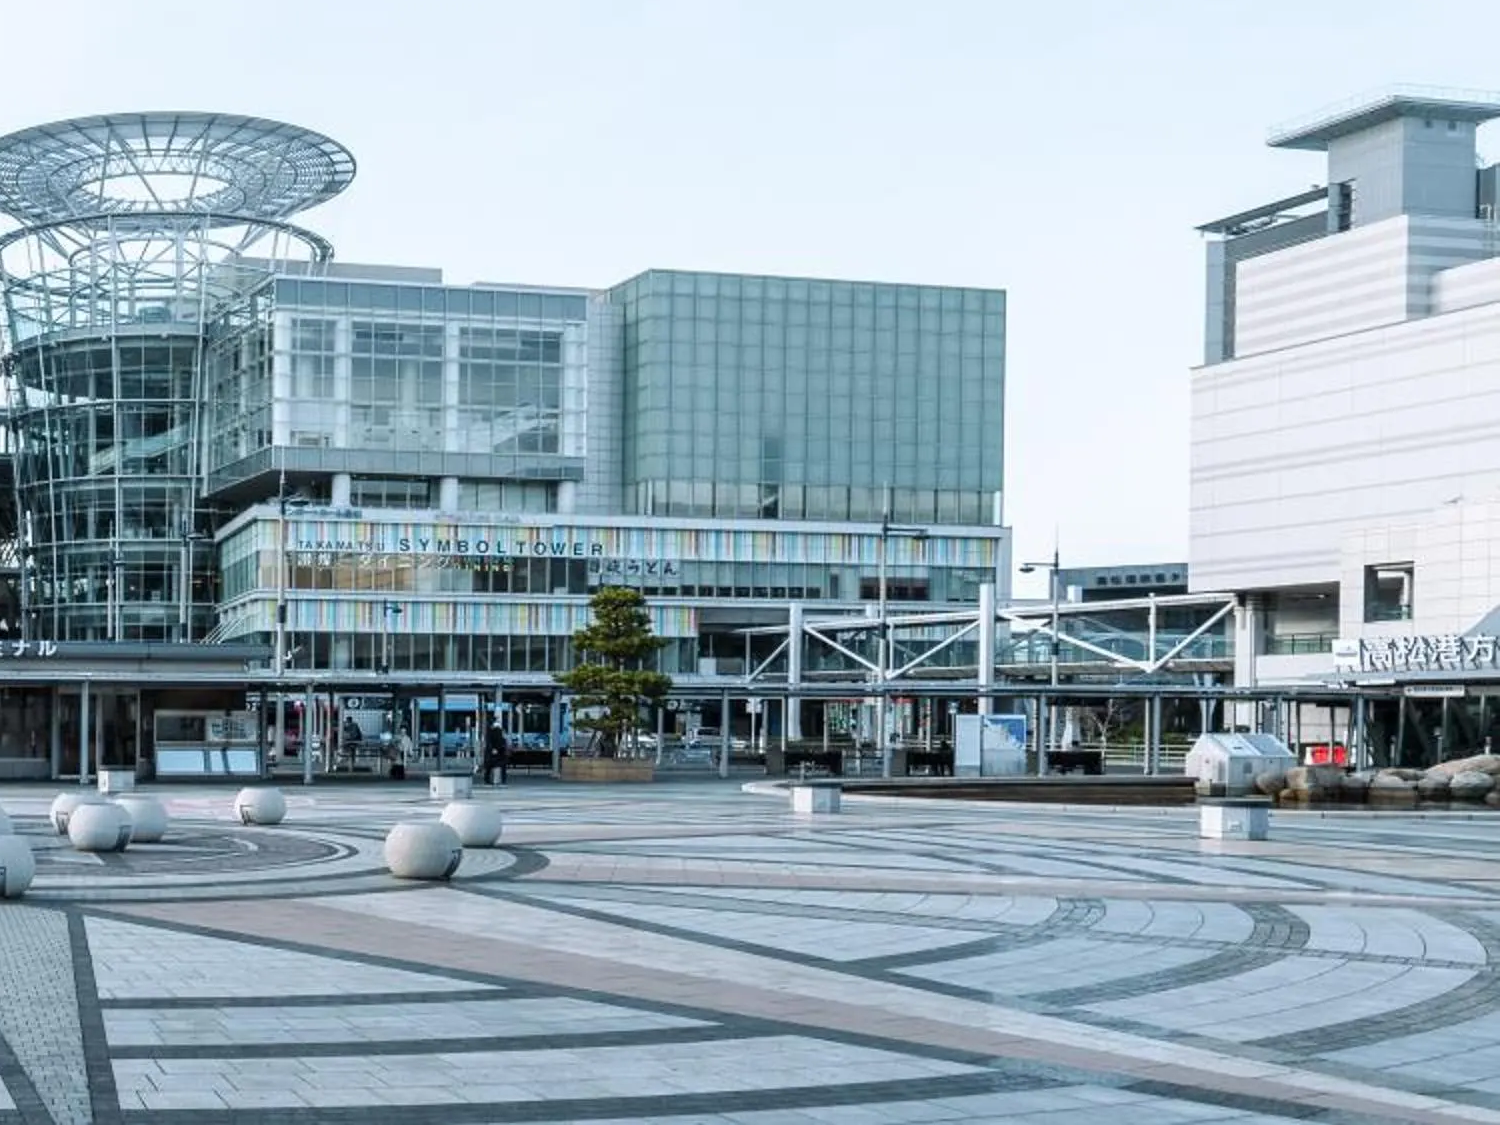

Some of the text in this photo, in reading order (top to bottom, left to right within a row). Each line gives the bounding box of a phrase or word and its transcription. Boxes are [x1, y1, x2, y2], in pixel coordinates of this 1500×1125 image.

[299, 538, 604, 556] TAKAMATSU SYMBOL TOWER
